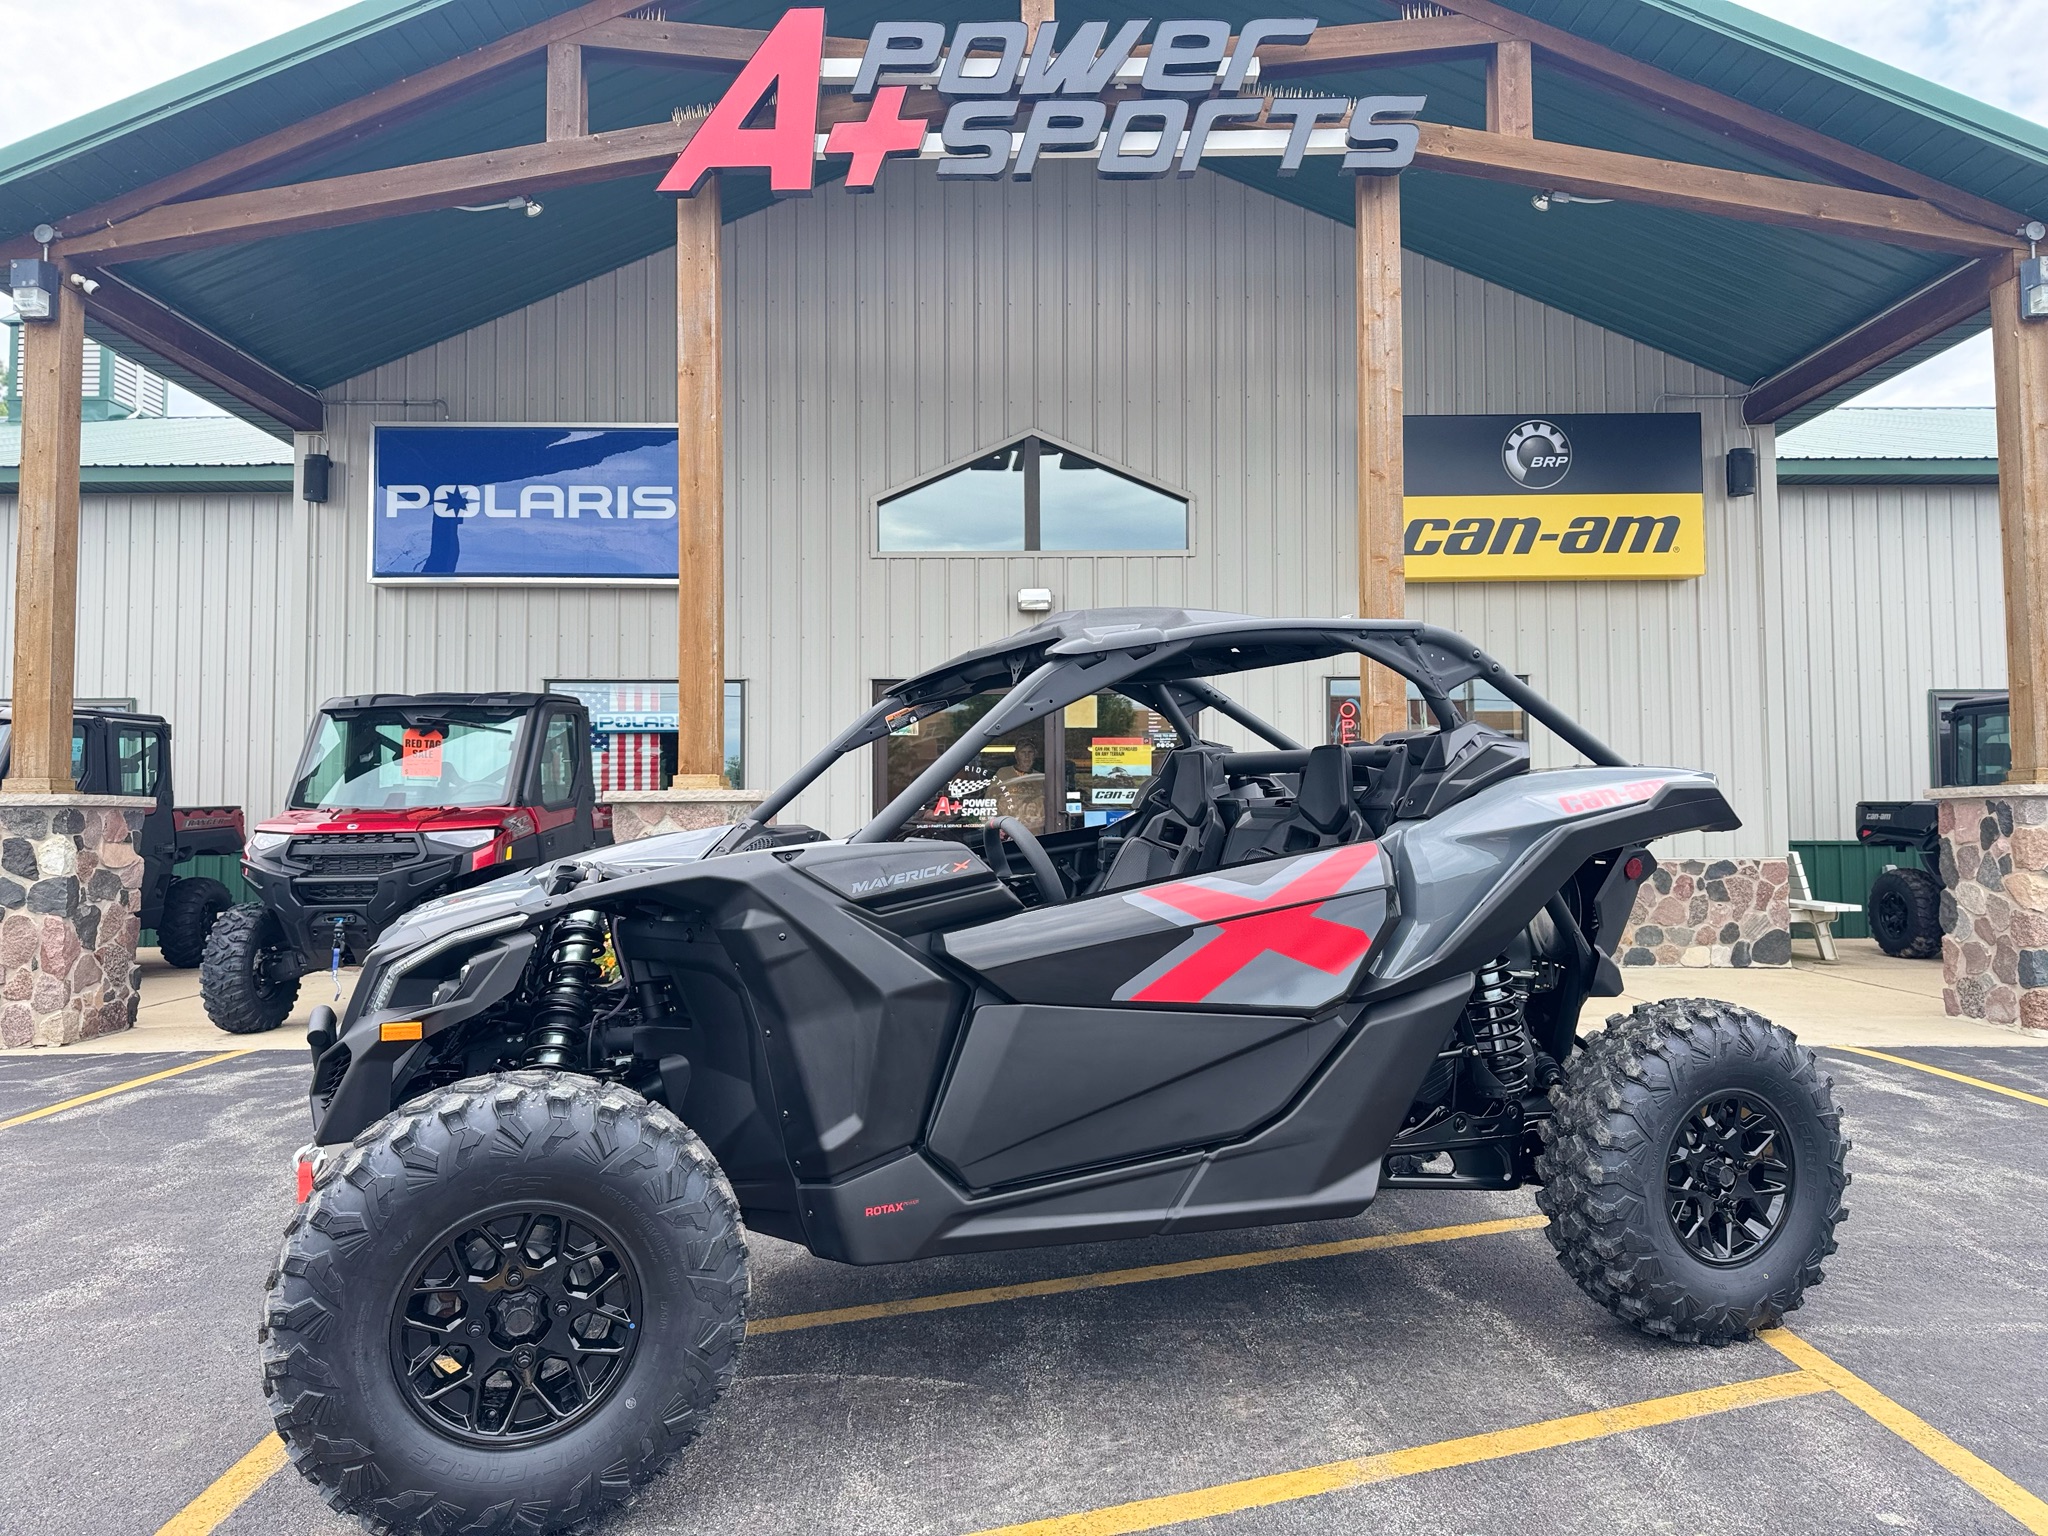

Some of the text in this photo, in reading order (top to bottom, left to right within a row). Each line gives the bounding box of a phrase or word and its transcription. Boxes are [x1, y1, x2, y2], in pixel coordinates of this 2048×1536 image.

[655, 7, 930, 195] A+
[1530, 456, 1568, 468] BRP
[386, 484, 677, 519] POLARIS
[599, 716, 679, 728] POLAR
[1340, 702, 1356, 744] OPE
[405, 739, 442, 749] RED TAG
[413, 749, 434, 759] SALE
[964, 765, 1015, 810] RIDE STARTS
[1095, 791, 1135, 799] can-a
[933, 796, 962, 816] A+
[963, 799, 997, 808] POWER
[961, 807, 998, 817] SPORTS
[186, 818, 225, 828] RANGER
[851, 863, 950, 894] MAVERICK
[865, 1202, 904, 1217] ROTAX
